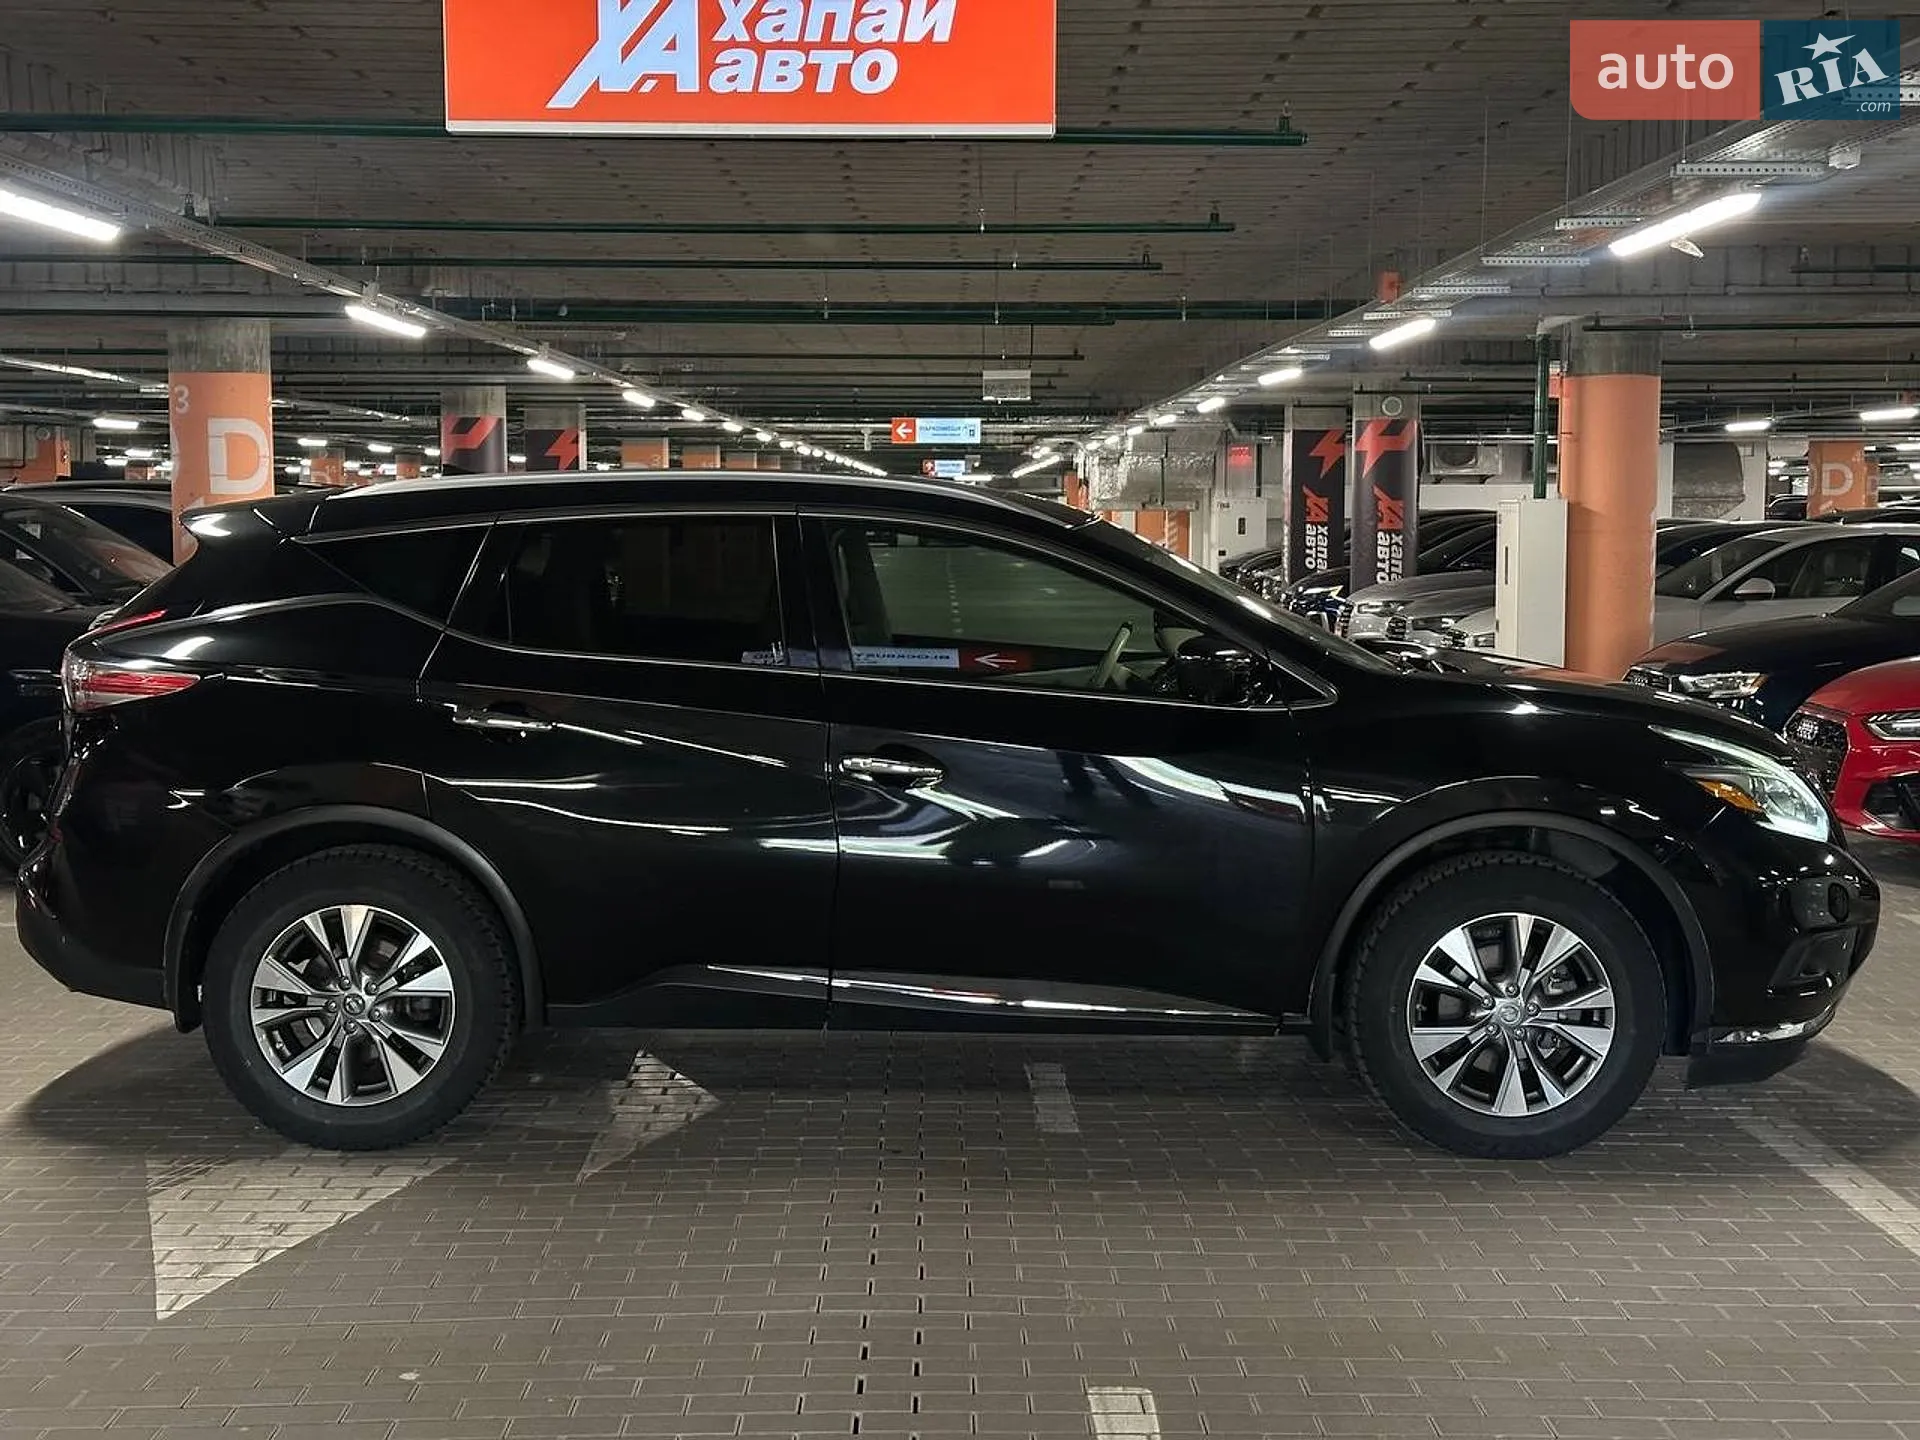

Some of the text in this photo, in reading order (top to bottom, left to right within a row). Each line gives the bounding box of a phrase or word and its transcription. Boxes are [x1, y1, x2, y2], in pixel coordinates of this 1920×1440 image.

[708, 48, 899, 94] авто
[174, 384, 190, 414] 3
[207, 417, 270, 495] D
[1821, 462, 1854, 496] D
[1317, 525, 1329, 574] хапа
